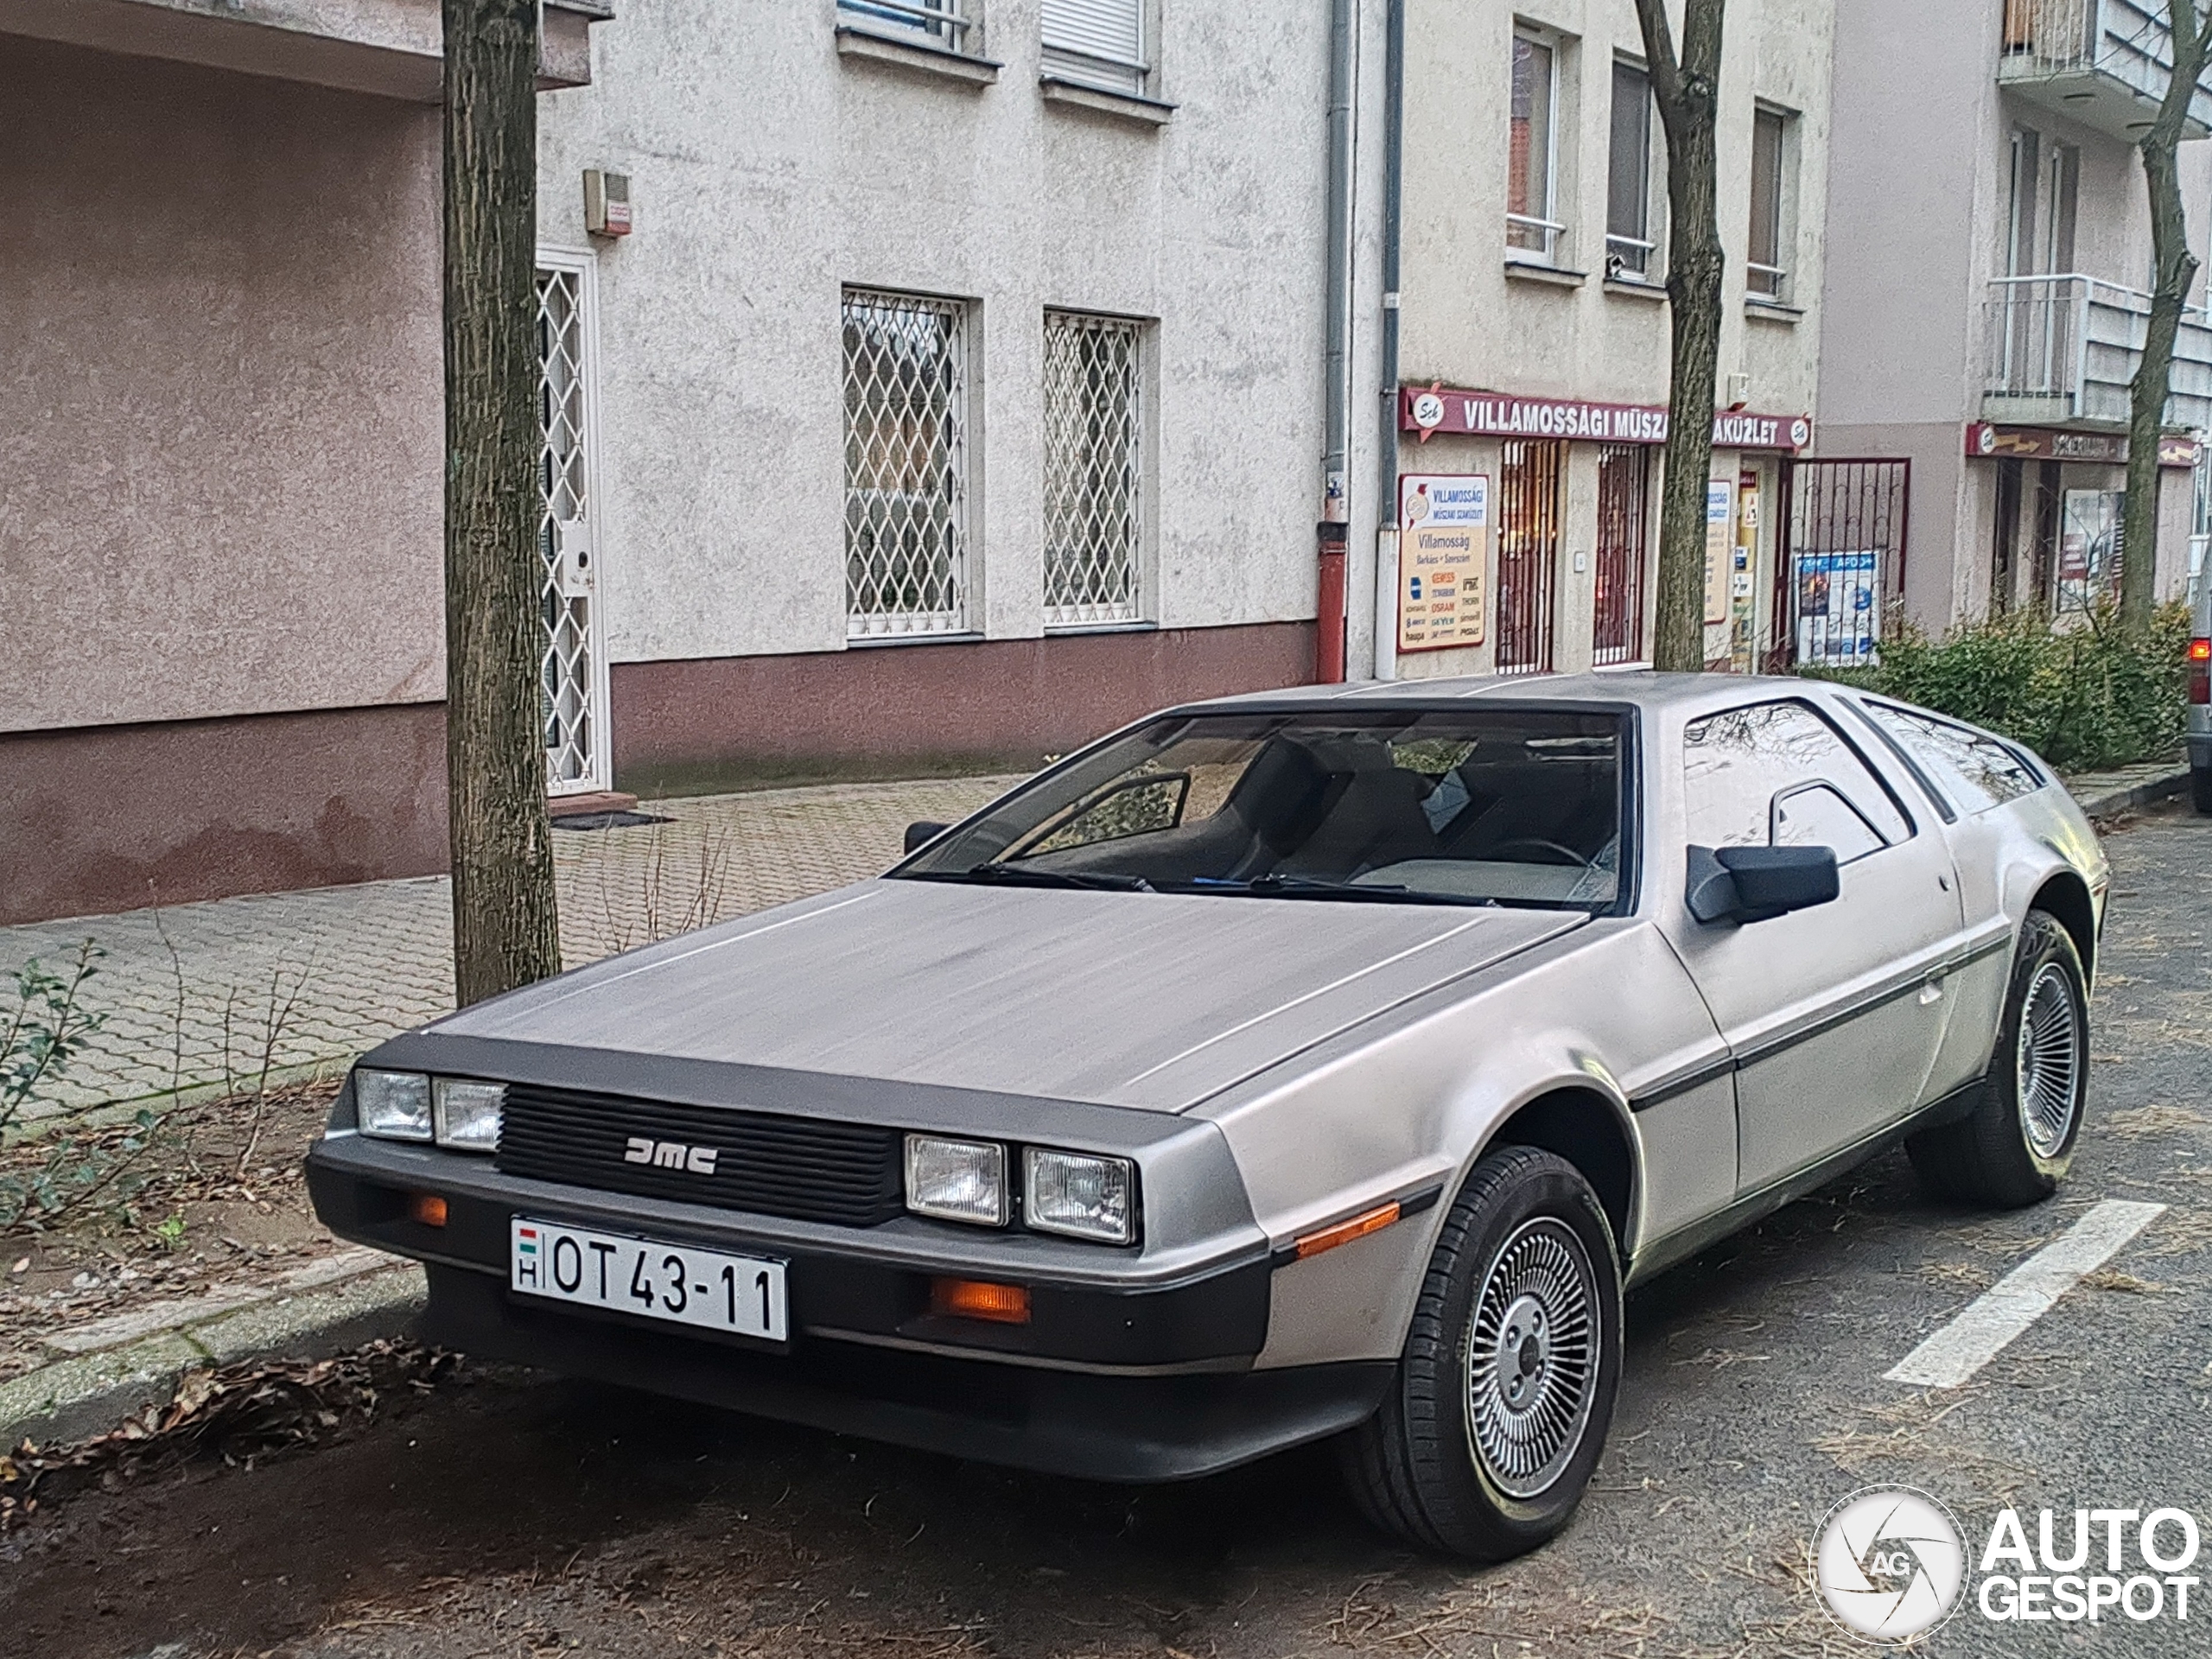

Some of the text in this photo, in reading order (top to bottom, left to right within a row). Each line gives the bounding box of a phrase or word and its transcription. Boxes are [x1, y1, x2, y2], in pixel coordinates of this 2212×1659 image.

[1464, 399, 1610, 436] VILLAMOSSÁGI
[1418, 532, 1470, 551] Villamosság
[519, 1257, 537, 1287] H
